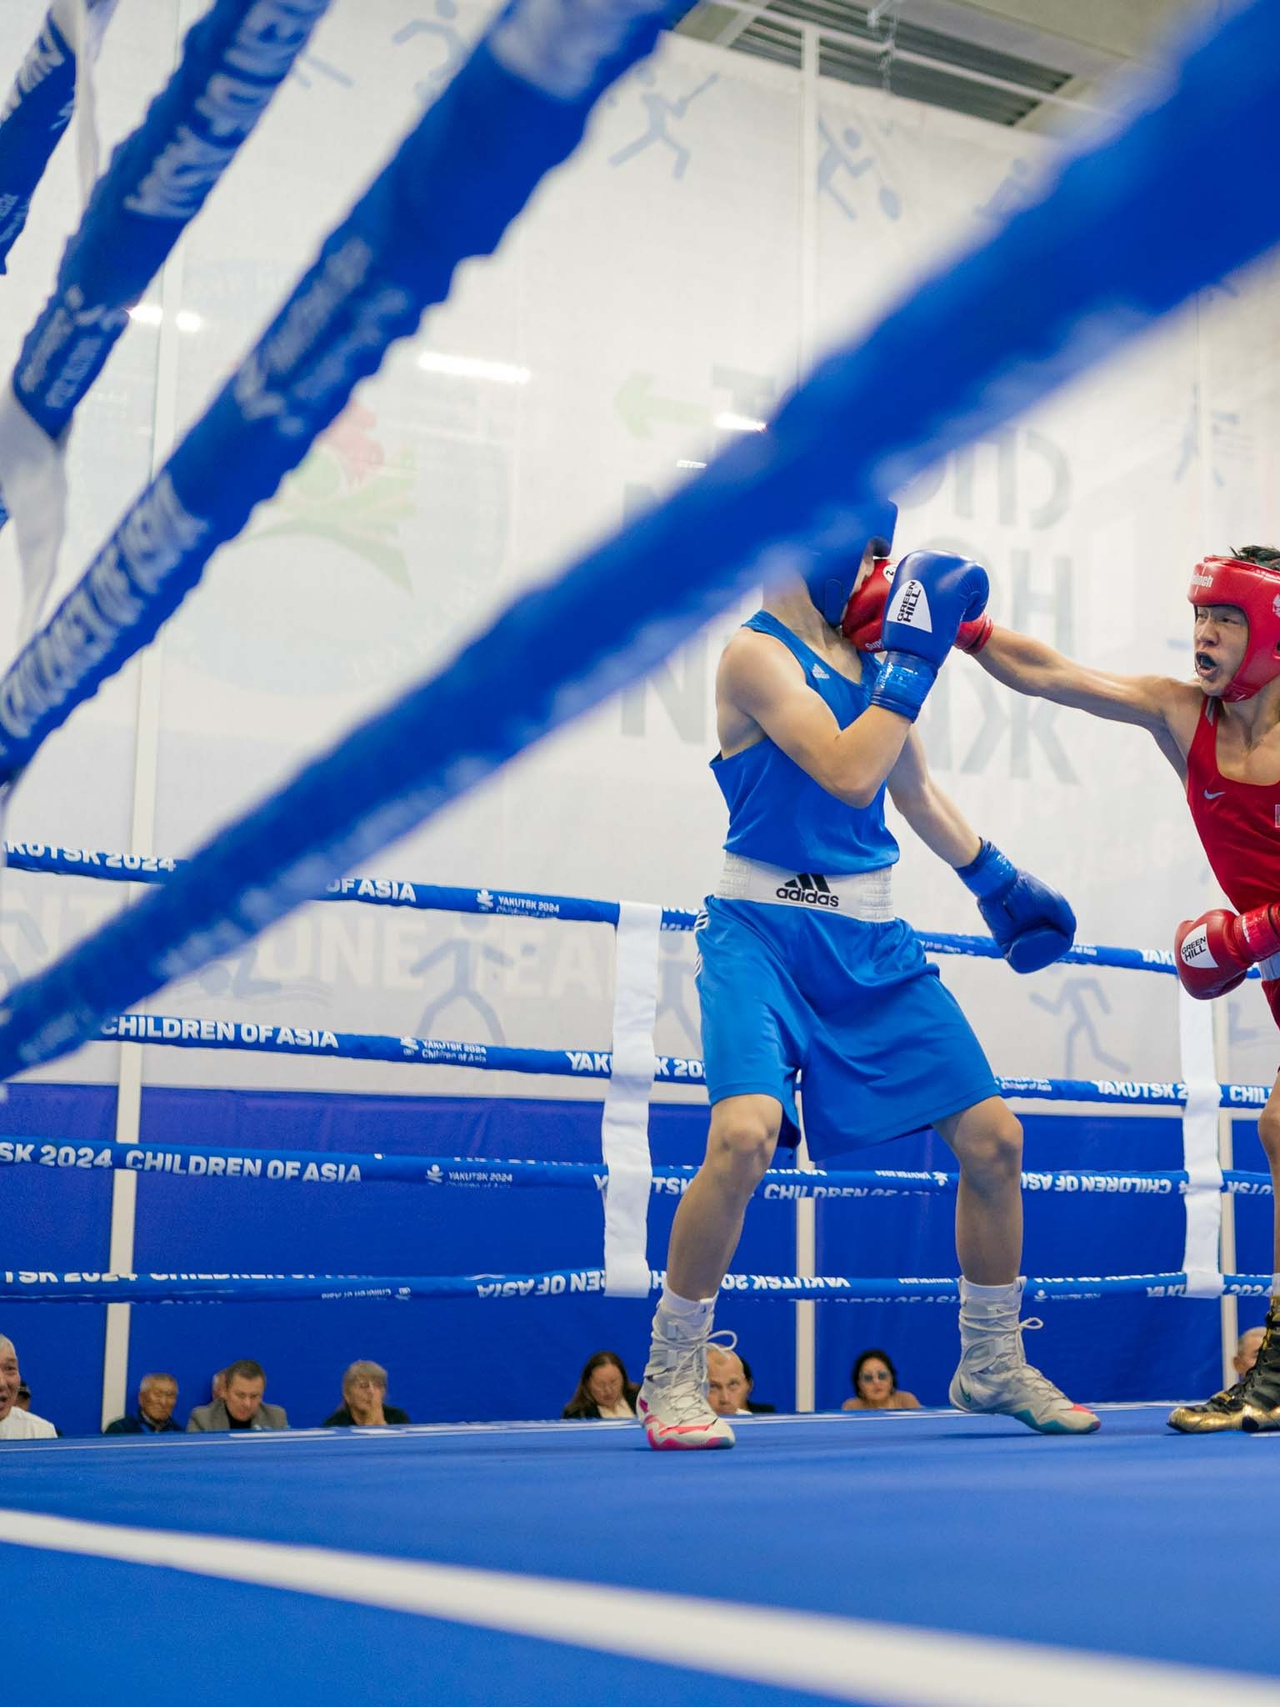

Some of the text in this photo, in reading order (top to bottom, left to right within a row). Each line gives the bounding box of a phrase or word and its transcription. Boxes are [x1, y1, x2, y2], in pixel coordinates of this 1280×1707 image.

[896, 581, 917, 622] GREEN
[903, 589, 922, 623] HILL
[358, 878, 417, 903] ASIA
[776, 887, 840, 908] adidas
[1181, 936, 1207, 955] GREEN
[1184, 944, 1207, 962] HILL
[100, 1015, 339, 1049] CHILDREN OF ASIA
[1091, 1080, 1175, 1099] YAKUTSK
[39, 1145, 113, 1169] 2024
[125, 1149, 262, 1178] CHILDREN
[267, 1159, 301, 1180] OF
[302, 1161, 362, 1183] ASIA
[1054, 1174, 1079, 1193] OF
